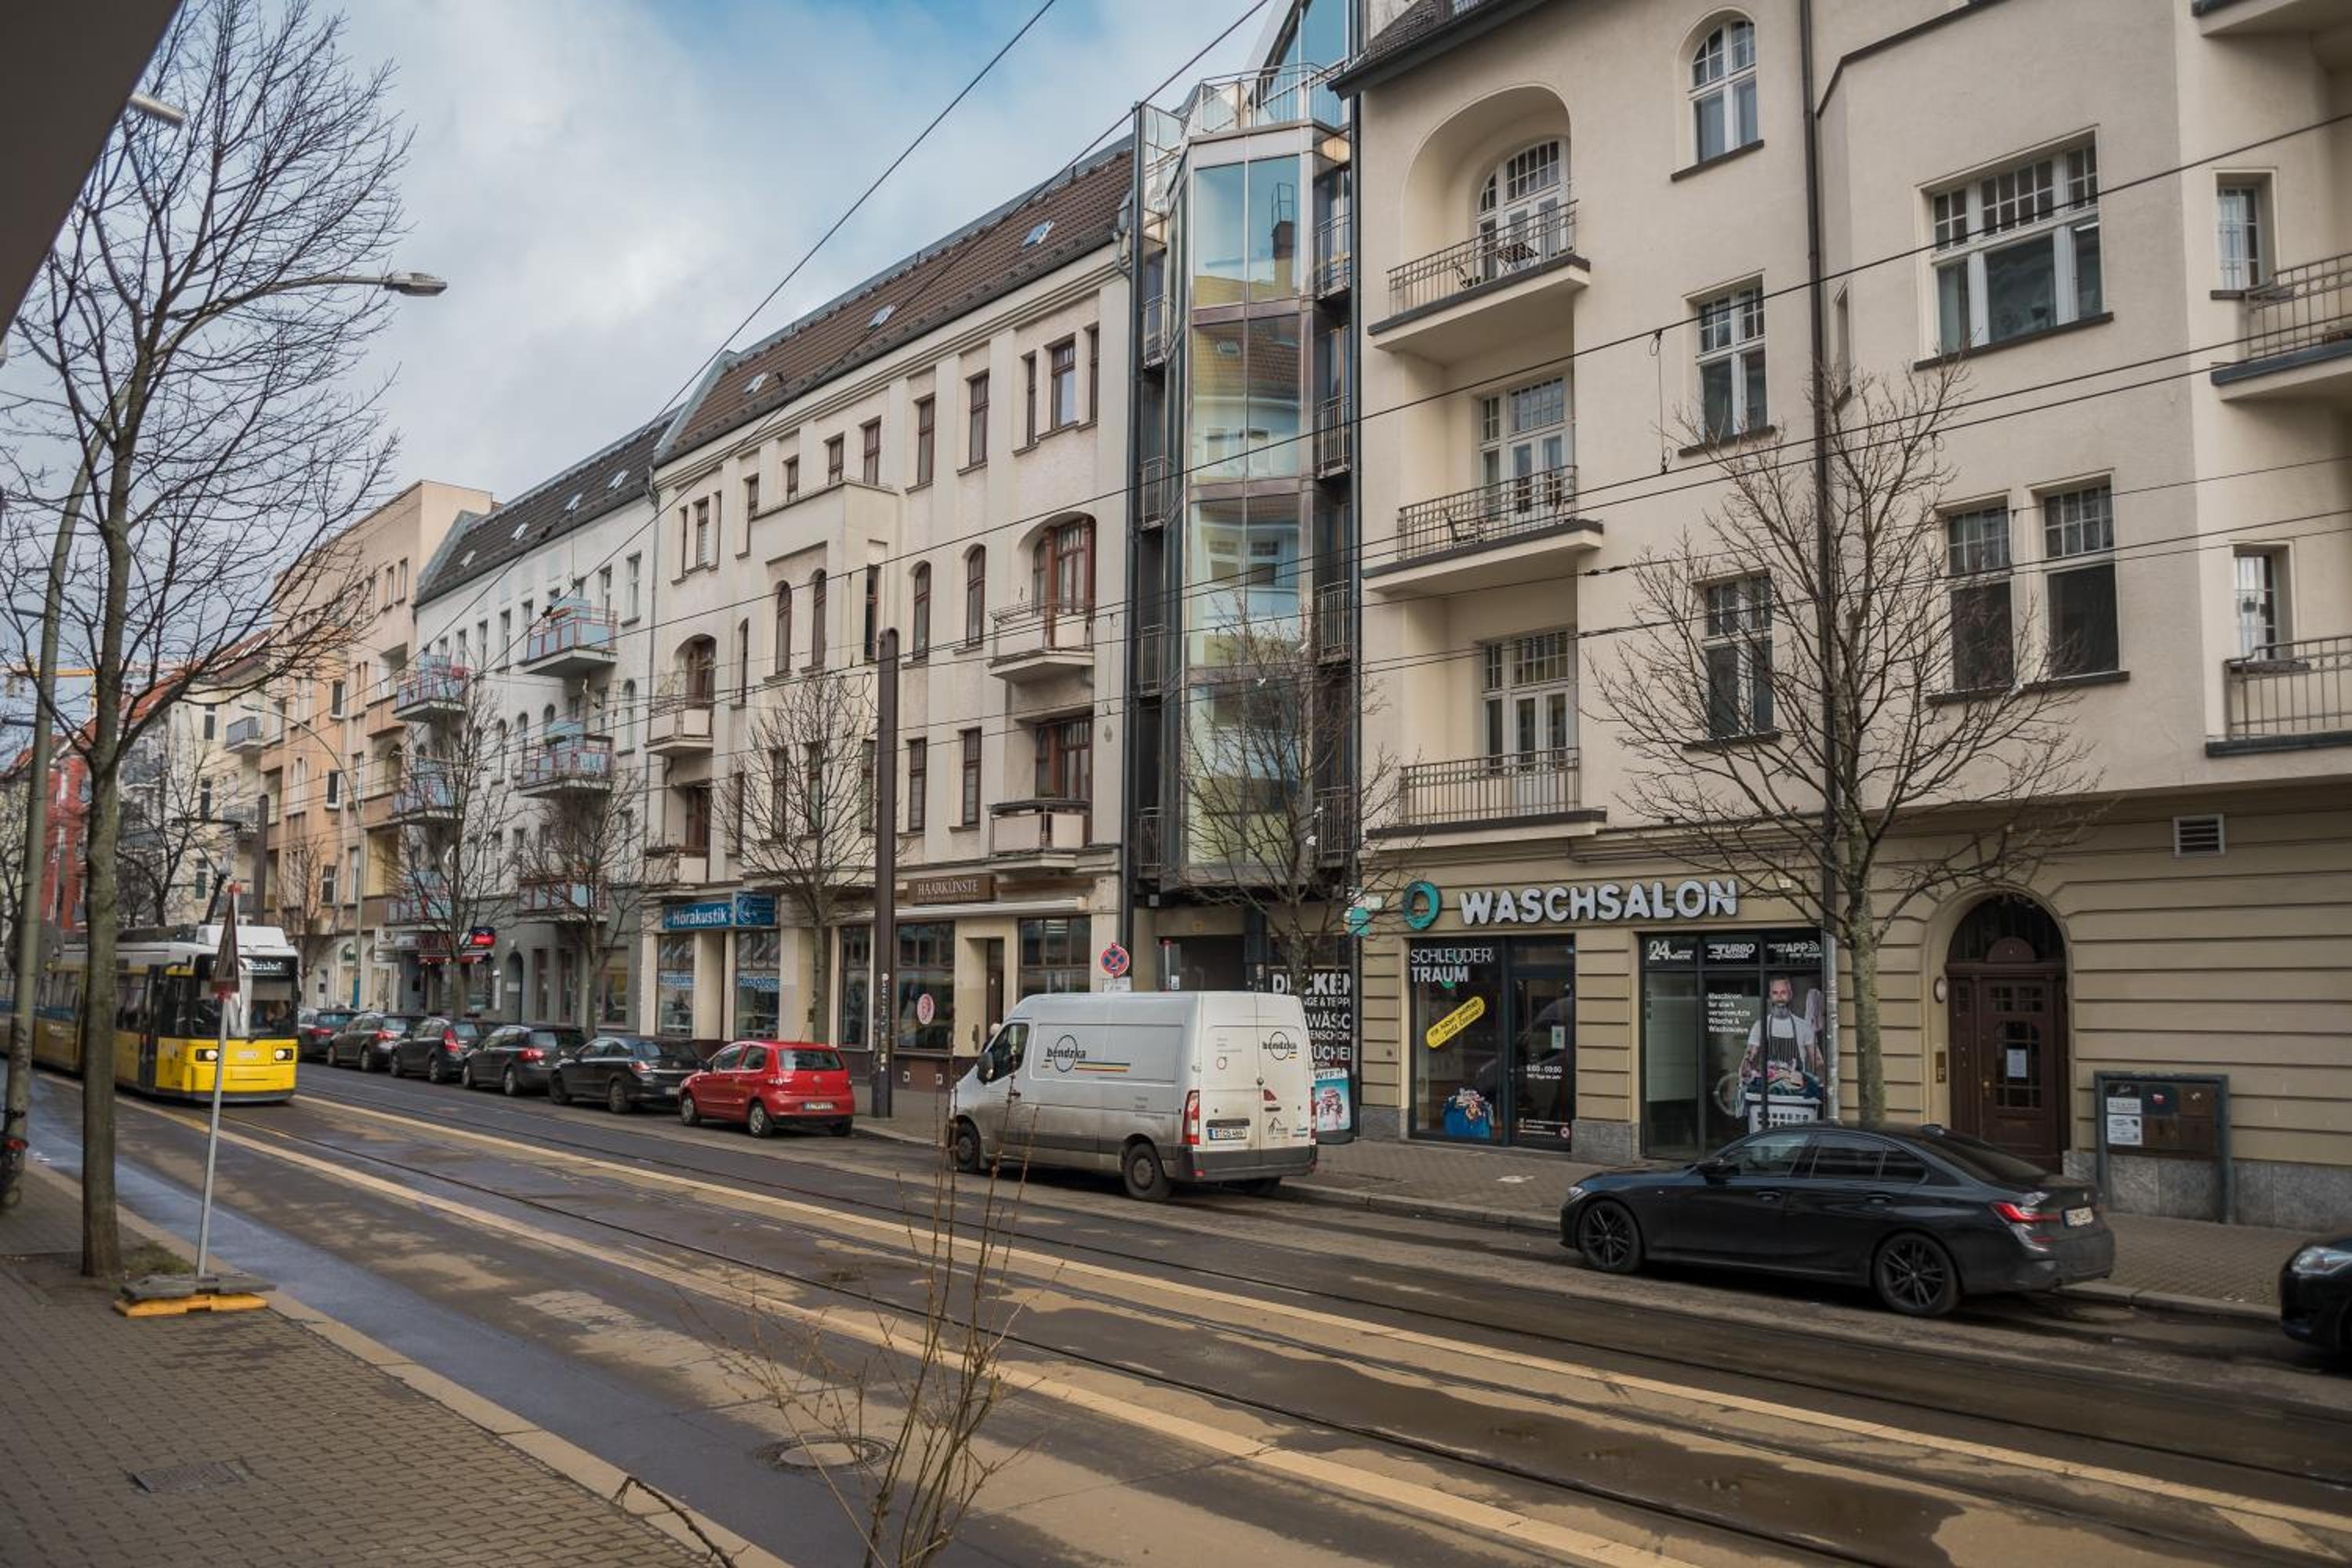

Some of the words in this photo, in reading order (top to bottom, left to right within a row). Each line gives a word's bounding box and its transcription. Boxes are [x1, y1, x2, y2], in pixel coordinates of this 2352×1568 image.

[1458, 880, 1738, 925] WASCHSALON
[1648, 940, 1671, 960] 24
[1785, 942, 1809, 953] APP
[1410, 948, 1493, 964] SCHLEUDER
[1411, 966, 1468, 982] TRAUM
